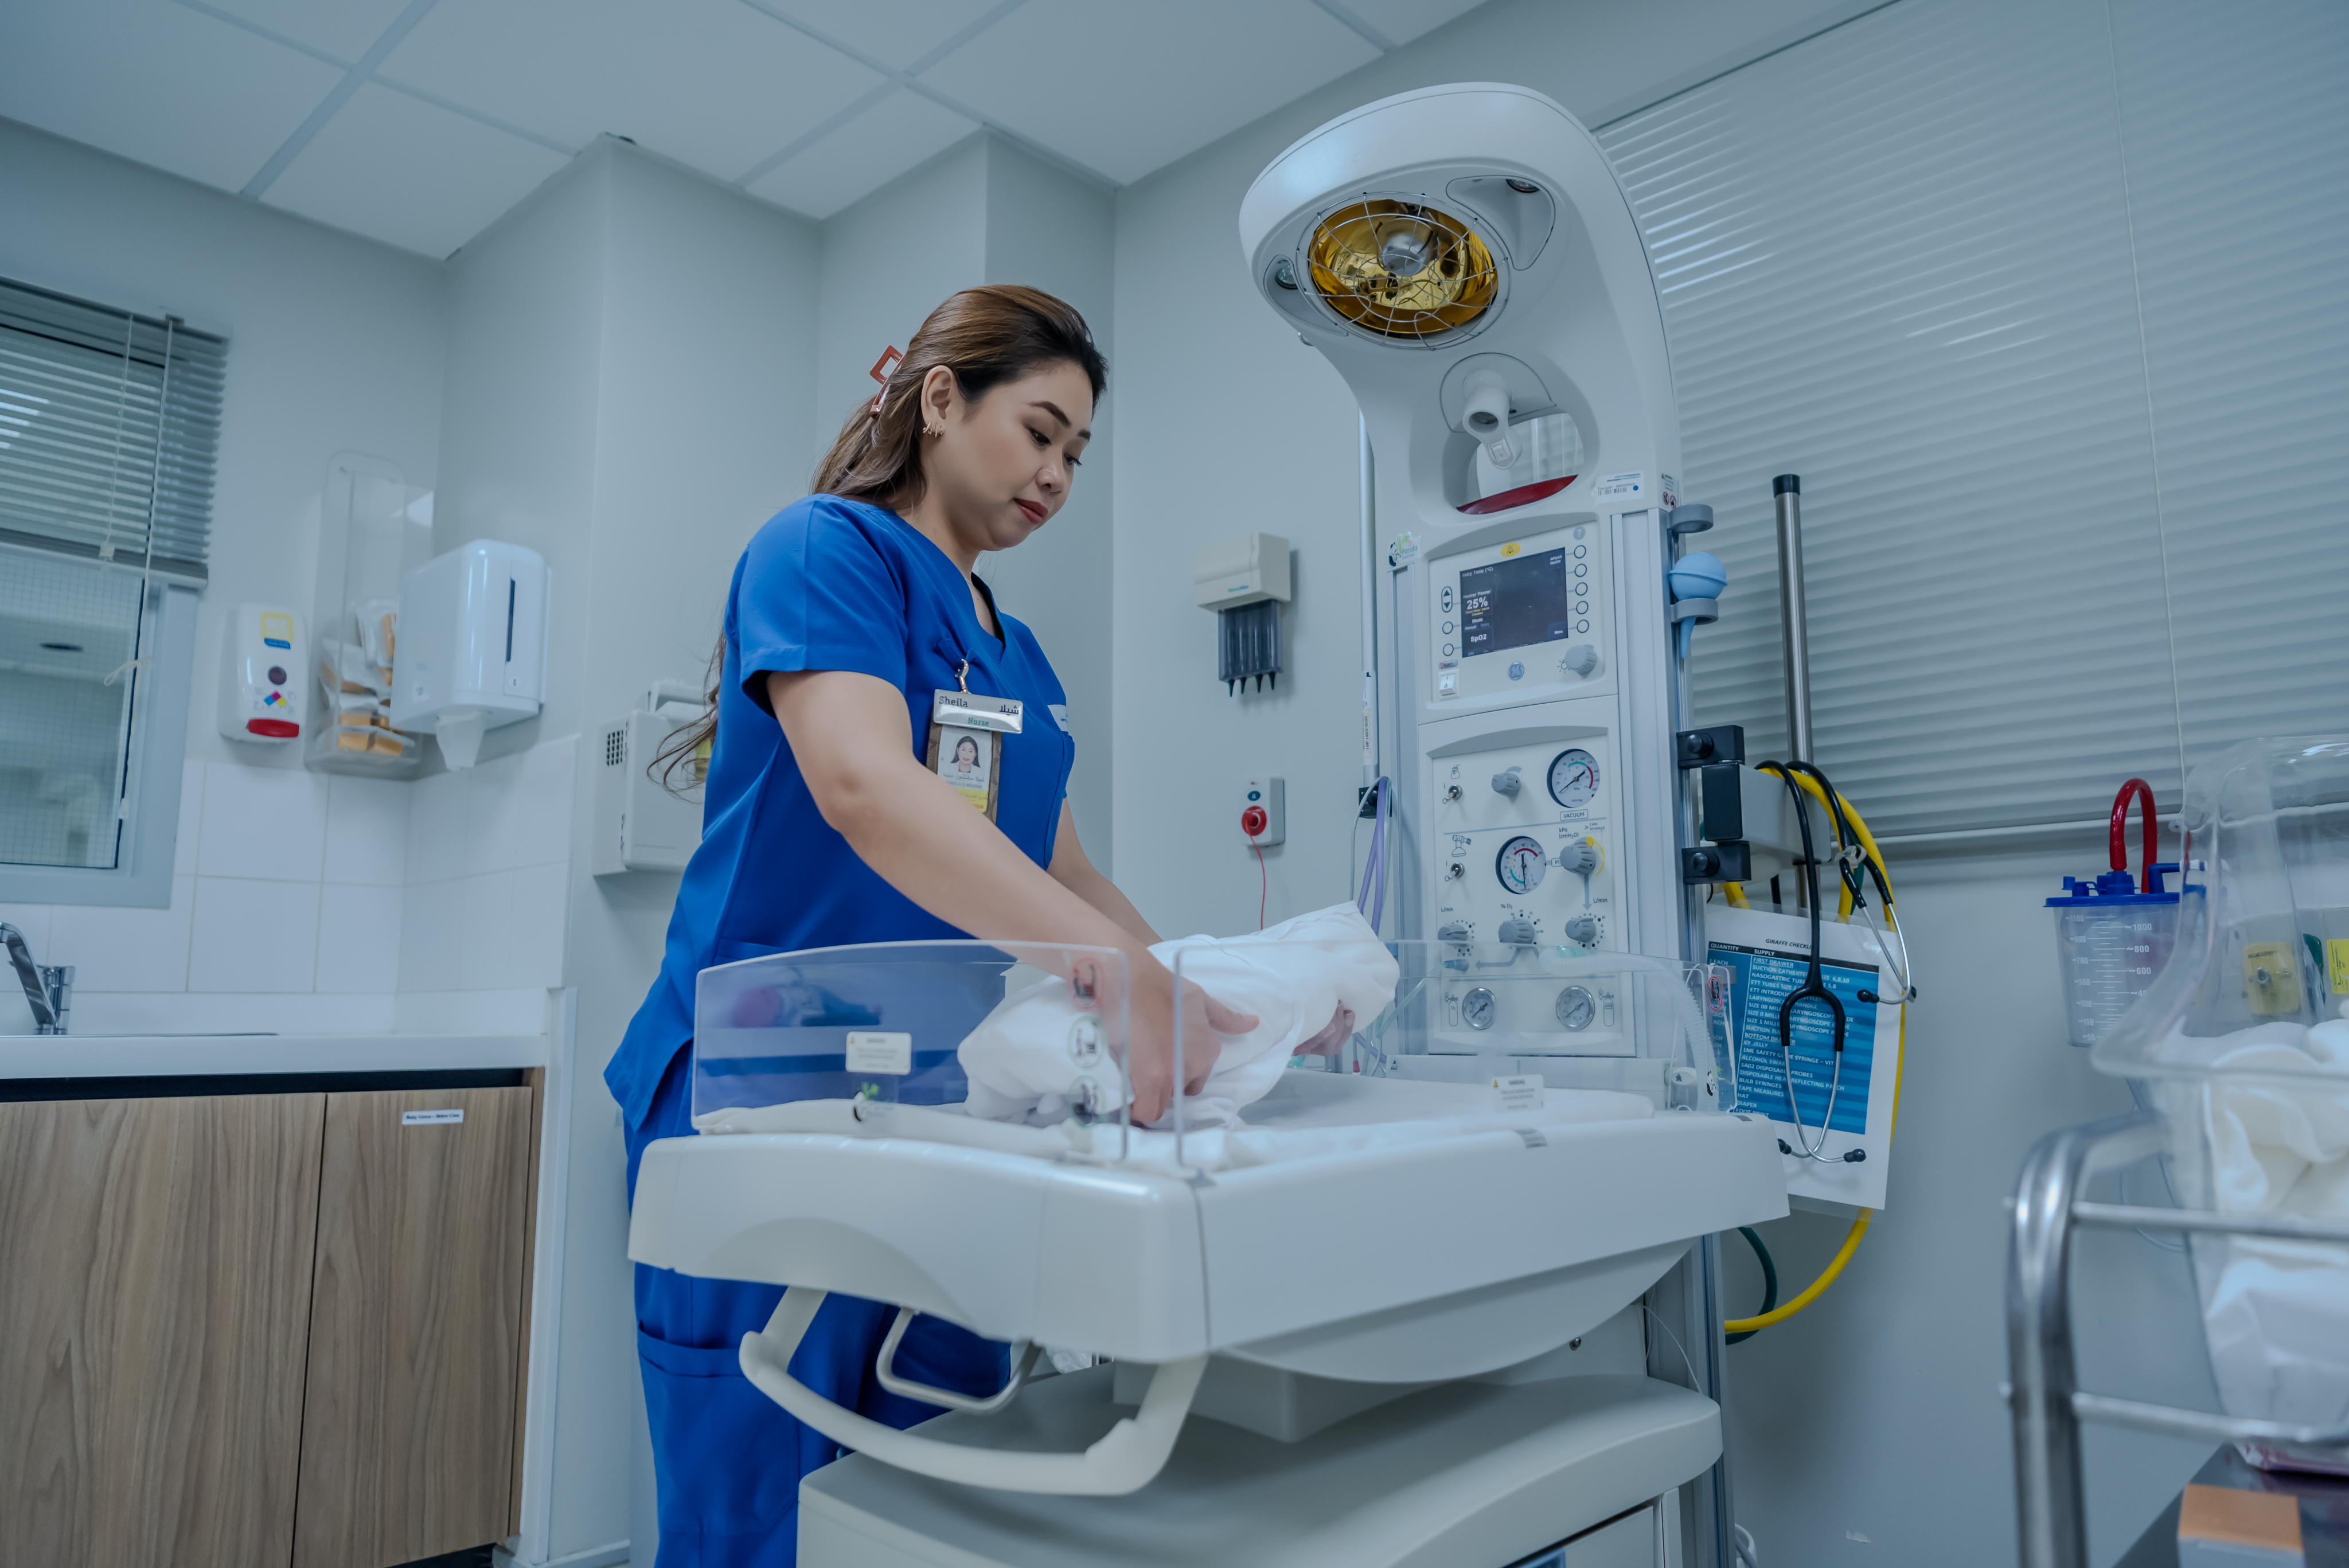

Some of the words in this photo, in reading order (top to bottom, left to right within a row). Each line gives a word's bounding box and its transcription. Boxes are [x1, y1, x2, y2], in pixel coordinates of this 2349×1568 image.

[1402, 545, 1418, 555] Panda
[1466, 596, 1488, 610] 25%
[1470, 634, 1486, 642] SpO2
[939, 696, 968, 708] Sheila
[967, 717, 989, 726] Nurse
[1766, 938, 1788, 946] GIRAFFE
[1710, 943, 1739, 951] QUANTITY
[1769, 958, 1793, 968] DRAWER
[1778, 968, 1808, 977] CATHERTE
[1751, 973, 1790, 982] NASOGASTRIC
[1789, 1016, 1830, 1026] ARYNGOSCOPE
[1746, 1025, 1770, 1033] SUCTION
[1789, 1024, 1829, 1034] ARYNGOSCOPE
[1745, 1032, 1769, 1040] BOTTOM
[1771, 1036, 1796, 1045] DRAER
[1742, 1055, 1767, 1063] ALCOHOL
[1795, 1055, 1819, 1063] SYRINGE
[1756, 1065, 1786, 1074] DISPOSABL
[1740, 1070, 1773, 1079] DISPOSABLE
[1791, 1078, 1824, 1087] REFLECTING
[1755, 1081, 1782, 1089] SYRINGES
[1753, 1088, 1784, 1097] MEASURES
